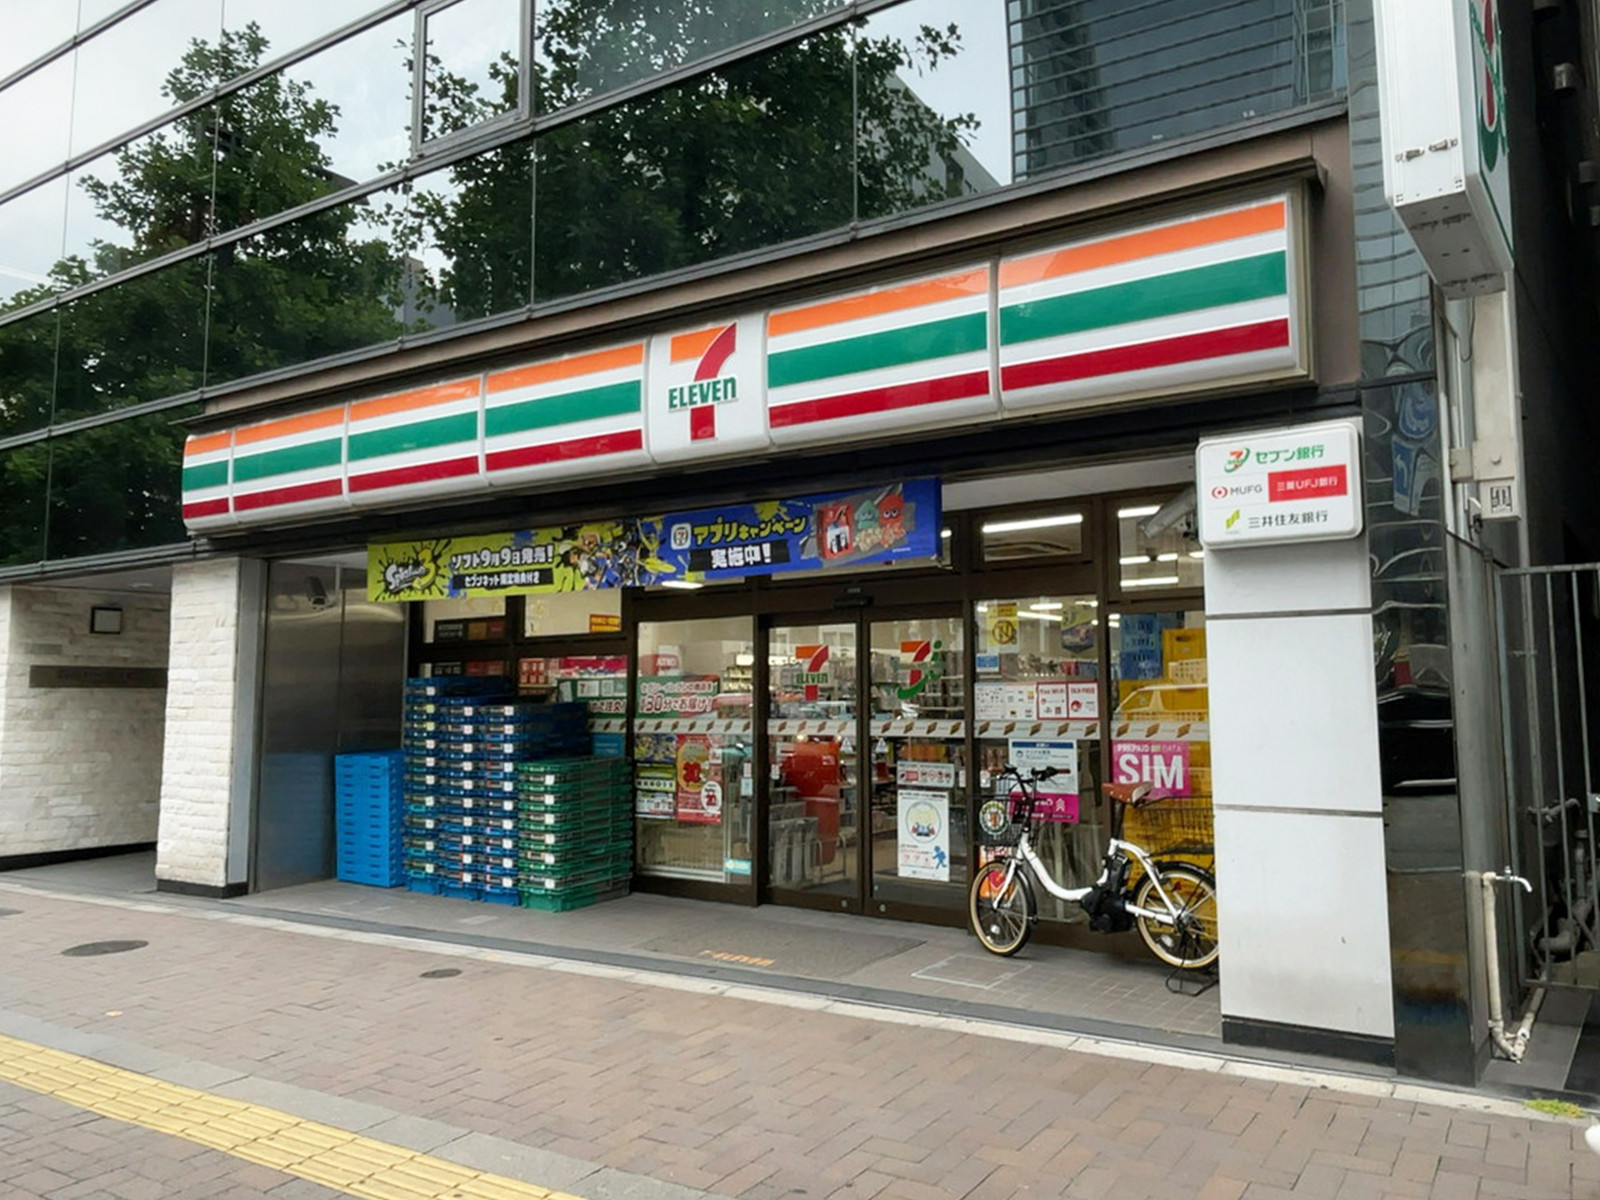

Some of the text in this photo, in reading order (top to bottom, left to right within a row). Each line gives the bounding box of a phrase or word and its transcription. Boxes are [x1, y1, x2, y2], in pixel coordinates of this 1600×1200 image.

[1255, 444, 1325, 465] セブン銀行
[1230, 484, 1263, 496] MUFG
[1248, 510, 1328, 529] 三井住友銀行
[693, 516, 807, 546] アプリキャンペーン
[1117, 753, 1184, 790] SIM
